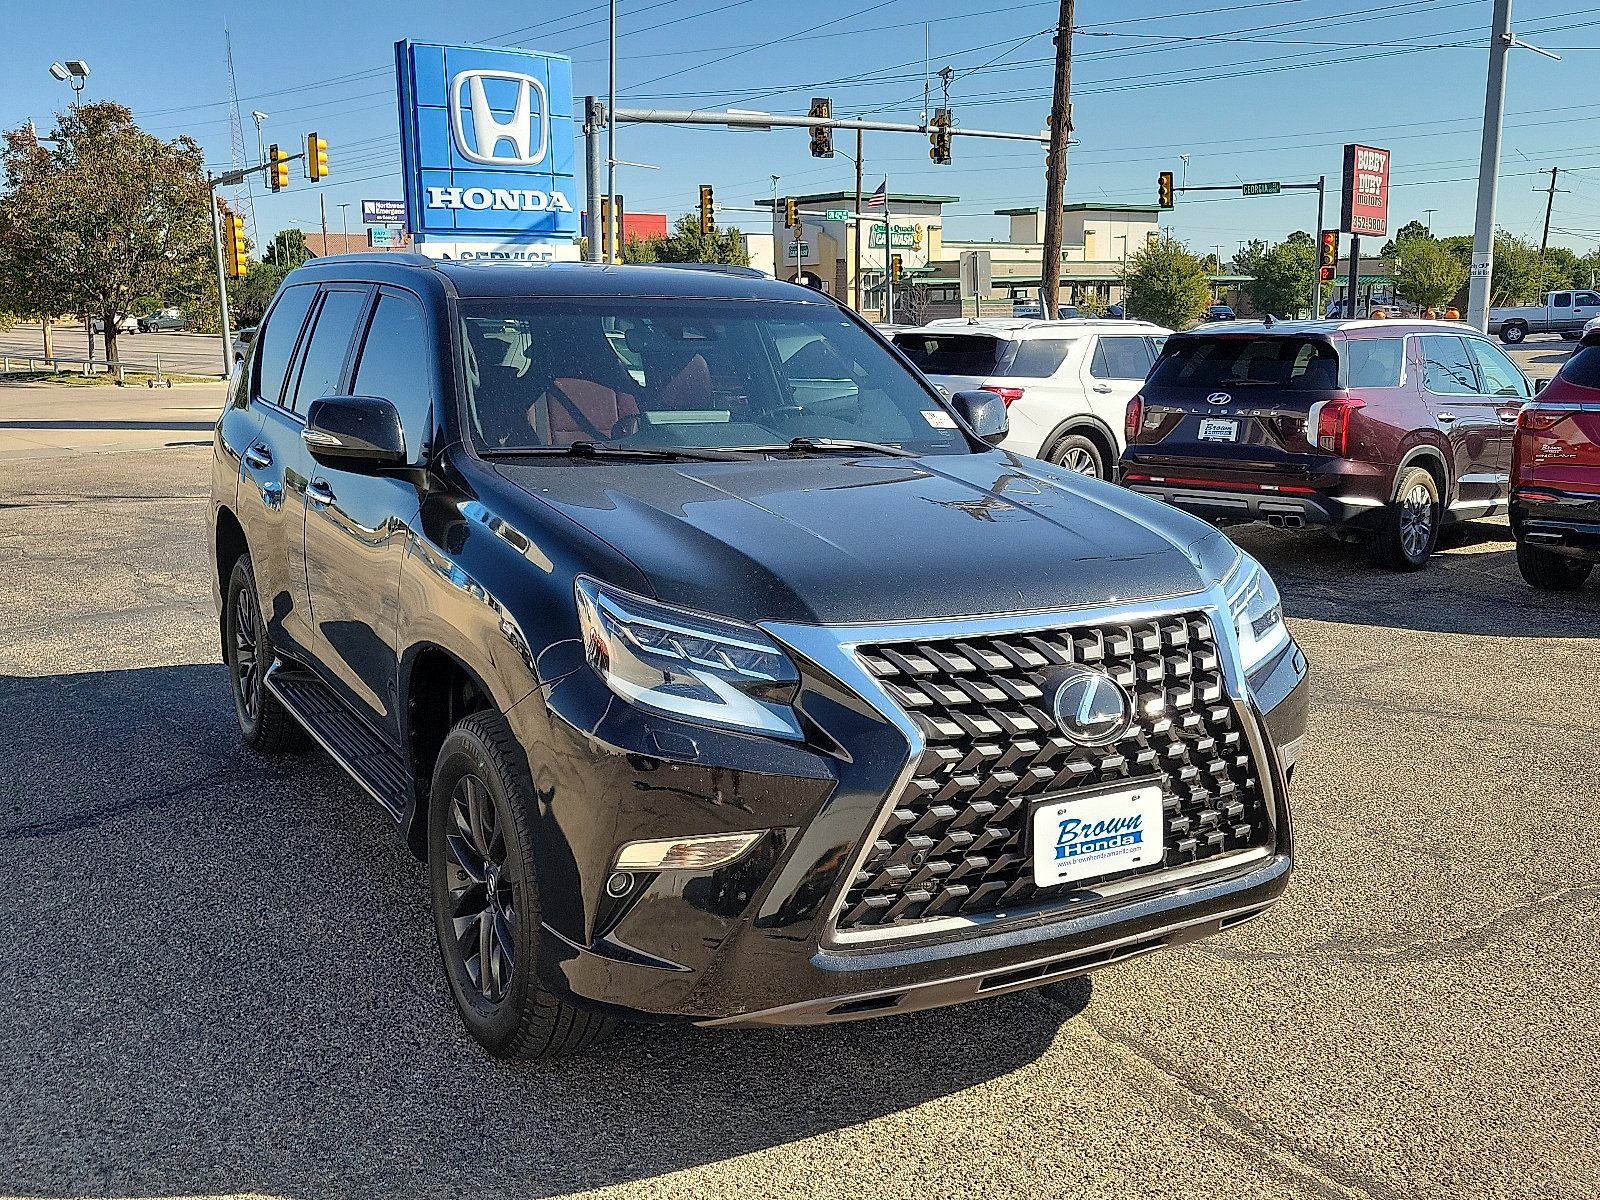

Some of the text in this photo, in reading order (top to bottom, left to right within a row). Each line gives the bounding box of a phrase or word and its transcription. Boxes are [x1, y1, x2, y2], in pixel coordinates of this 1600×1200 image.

[1357, 149, 1387, 174] BOBBY
[1243, 184, 1269, 195] GEORGIA
[1358, 173, 1383, 195] DUBY
[426, 187, 574, 213] HONDA
[1356, 194, 1383, 207] motors
[893, 224, 915, 233] Quack
[1353, 215, 1386, 231] 352-9800
[891, 233, 914, 246] WASH
[1056, 814, 1143, 845] Brown
[1064, 835, 1135, 857] Honda
